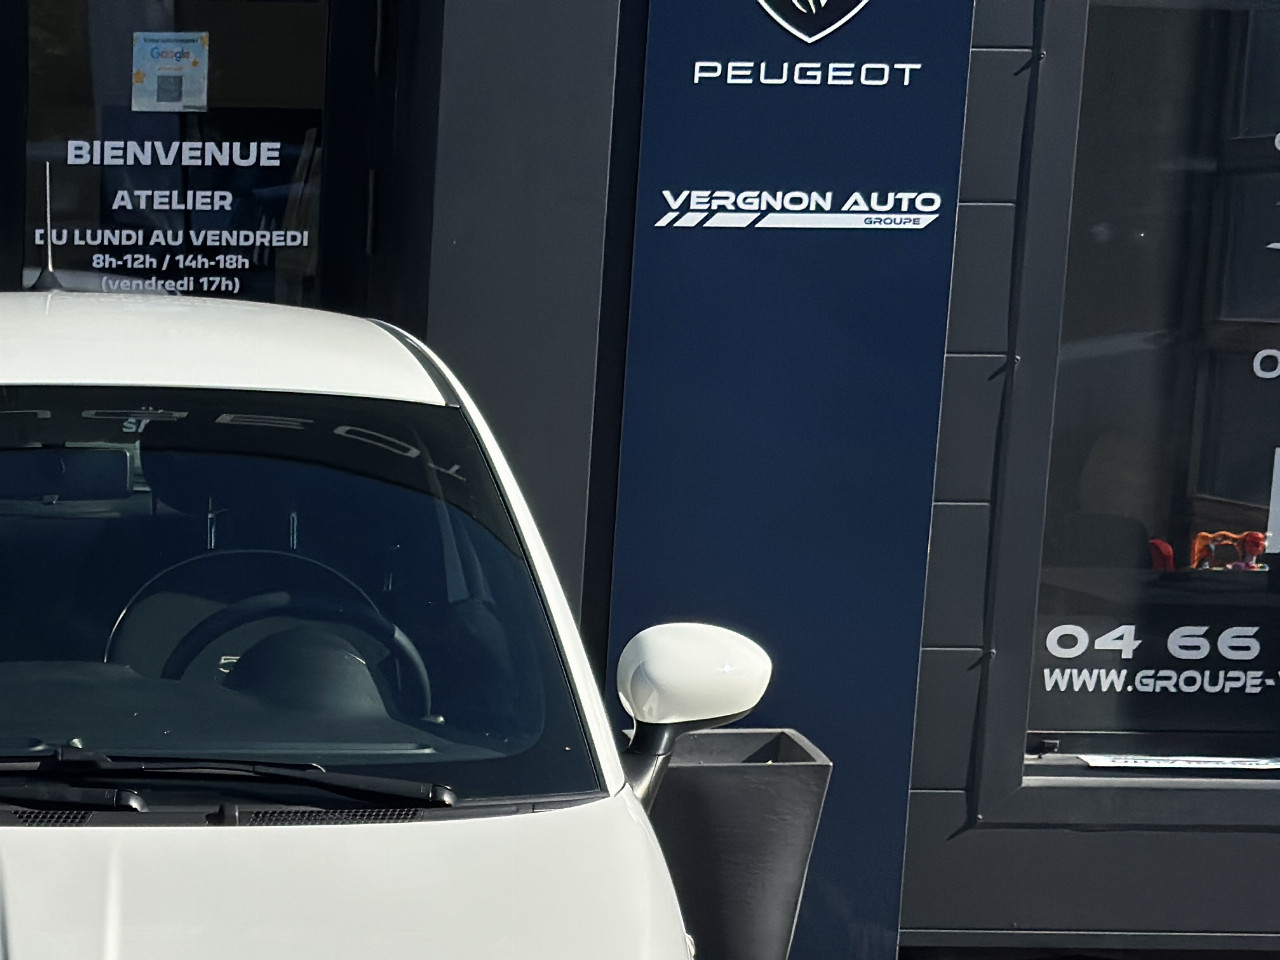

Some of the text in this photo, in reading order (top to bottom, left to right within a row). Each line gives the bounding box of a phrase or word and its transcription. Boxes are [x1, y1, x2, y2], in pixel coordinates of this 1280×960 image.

[150, 46, 191, 62] Google
[694, 62, 921, 85] PEUGEOT
[68, 140, 280, 166] BIENVENUE
[112, 190, 232, 210] ATELIER
[662, 191, 941, 211] VERGNON AUTO
[863, 216, 921, 227] GROUPE
[34, 228, 308, 246] DU LUNDI AU VENDREDI
[93, 254, 156, 268] 8h-12h
[175, 255, 249, 268] 14h-18h
[101, 276, 239, 293] (vendredi 17h)
[1046, 625, 1260, 660] 04 66
[1043, 667, 1276, 694] WWW.GROUPE-
